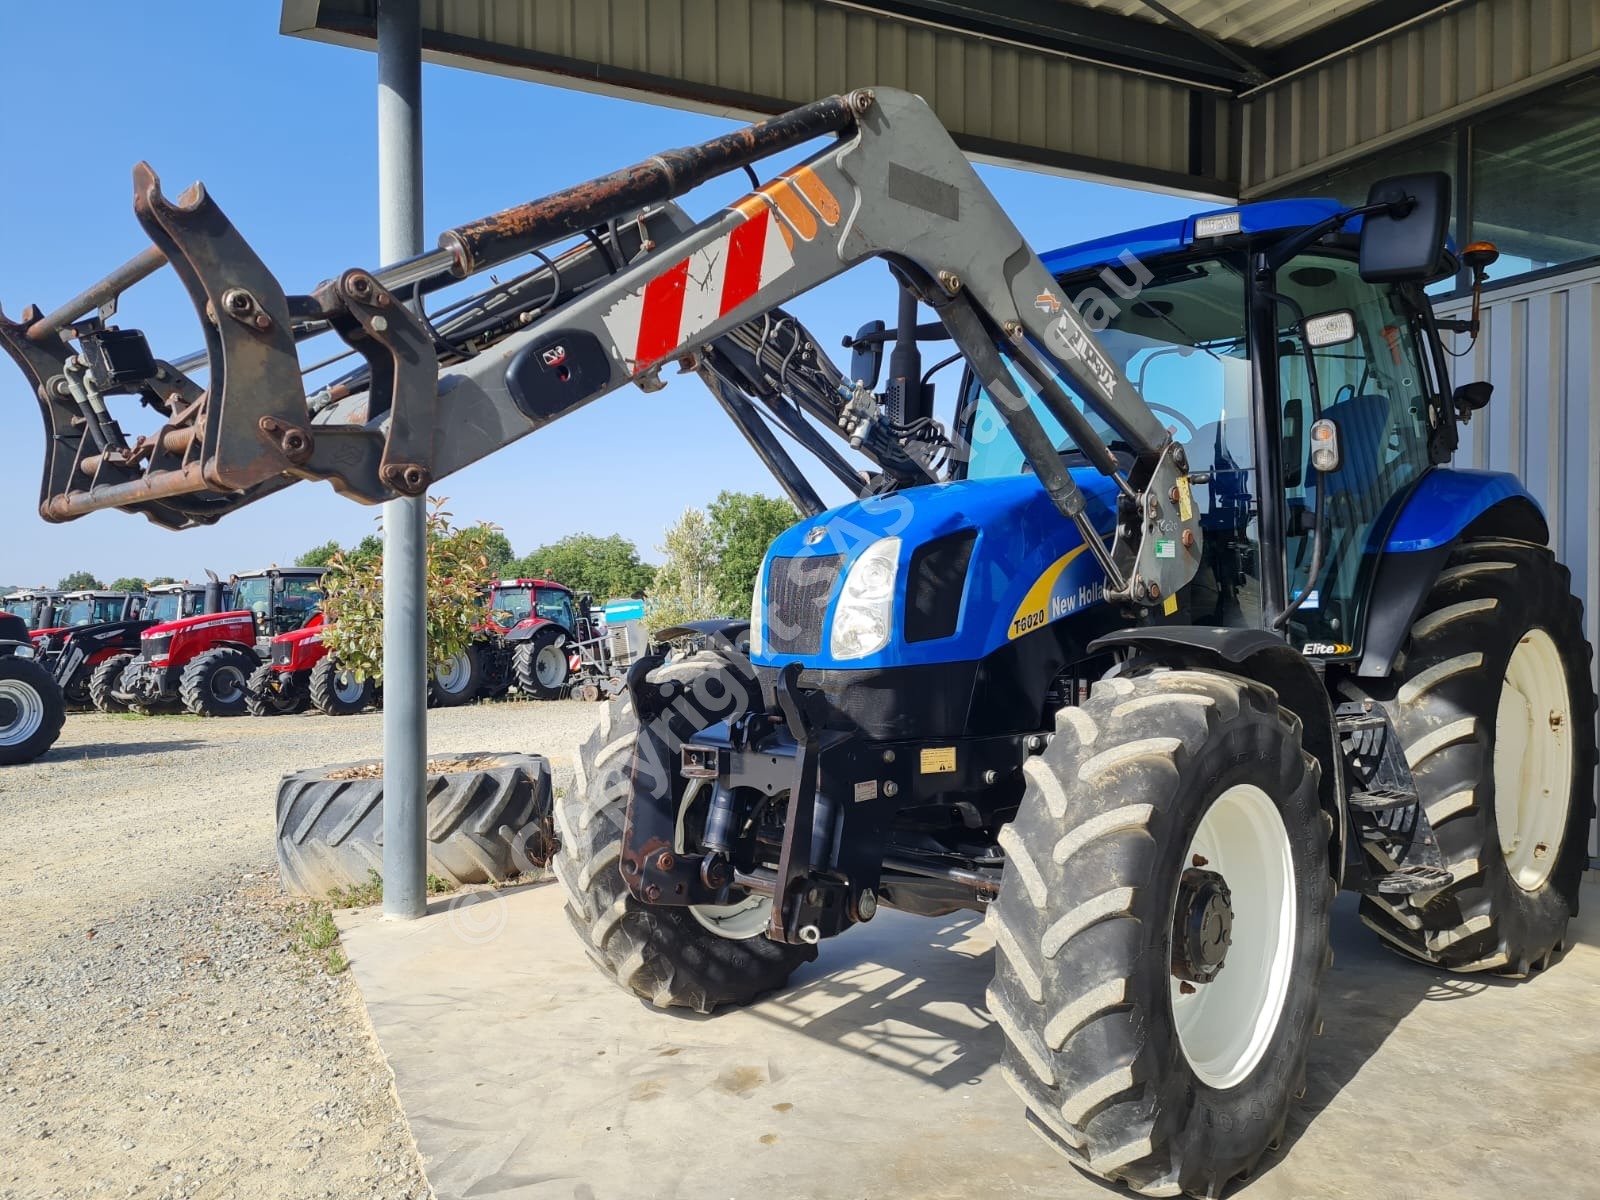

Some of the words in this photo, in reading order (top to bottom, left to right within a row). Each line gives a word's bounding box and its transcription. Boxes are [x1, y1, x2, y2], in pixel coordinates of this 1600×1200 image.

[1052, 595, 1076, 618] New
[1079, 582, 1104, 607] Holla
[1014, 609, 1044, 634] T6020
[1303, 643, 1335, 655] Elite
